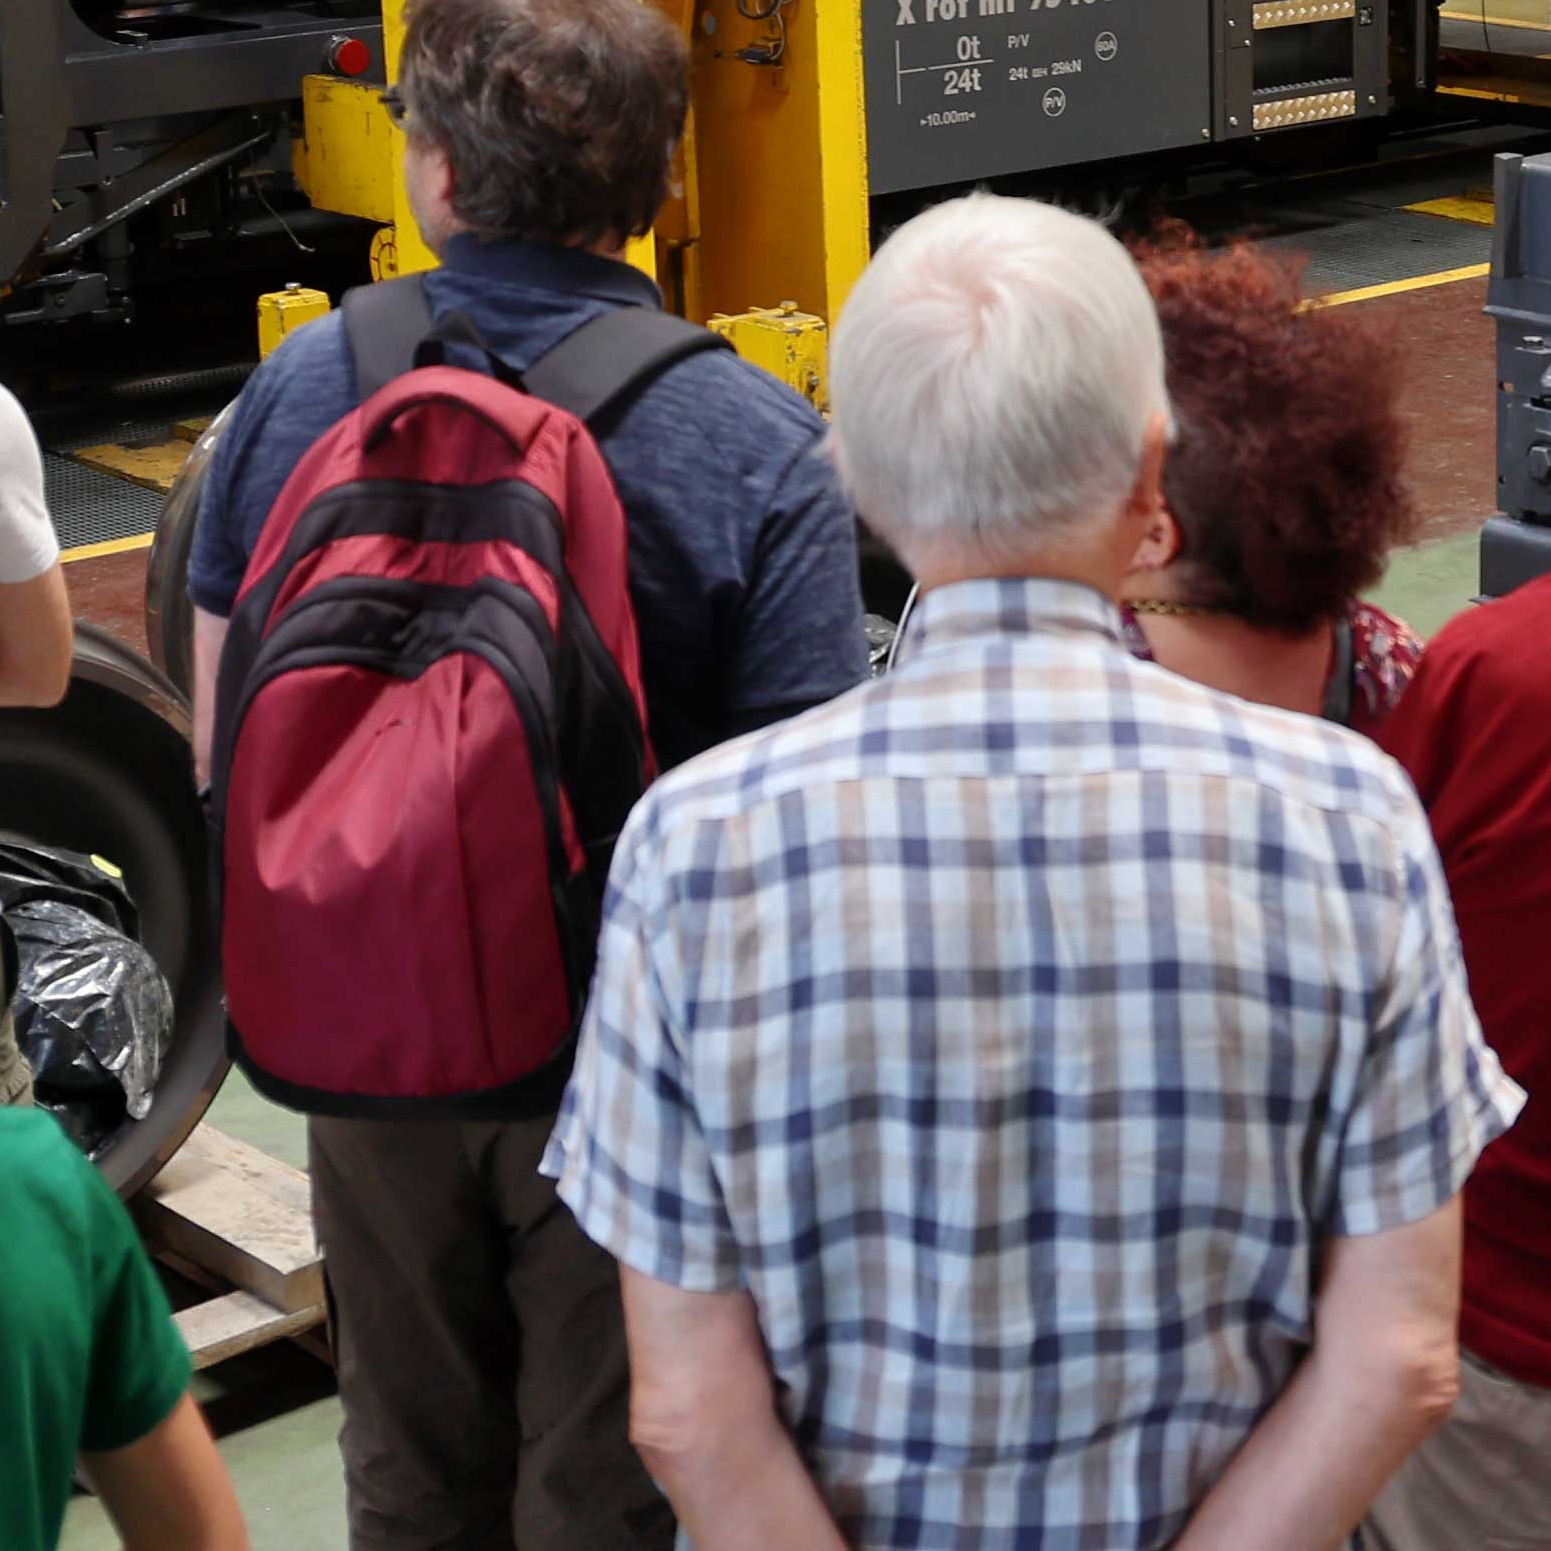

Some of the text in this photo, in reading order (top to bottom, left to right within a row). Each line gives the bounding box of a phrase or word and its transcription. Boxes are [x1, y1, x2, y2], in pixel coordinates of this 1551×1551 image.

[956, 35, 982, 61] 0t
[1007, 34, 1030, 49] P/V
[943, 67, 983, 96] 24t
[1009, 67, 1030, 81] 24t
